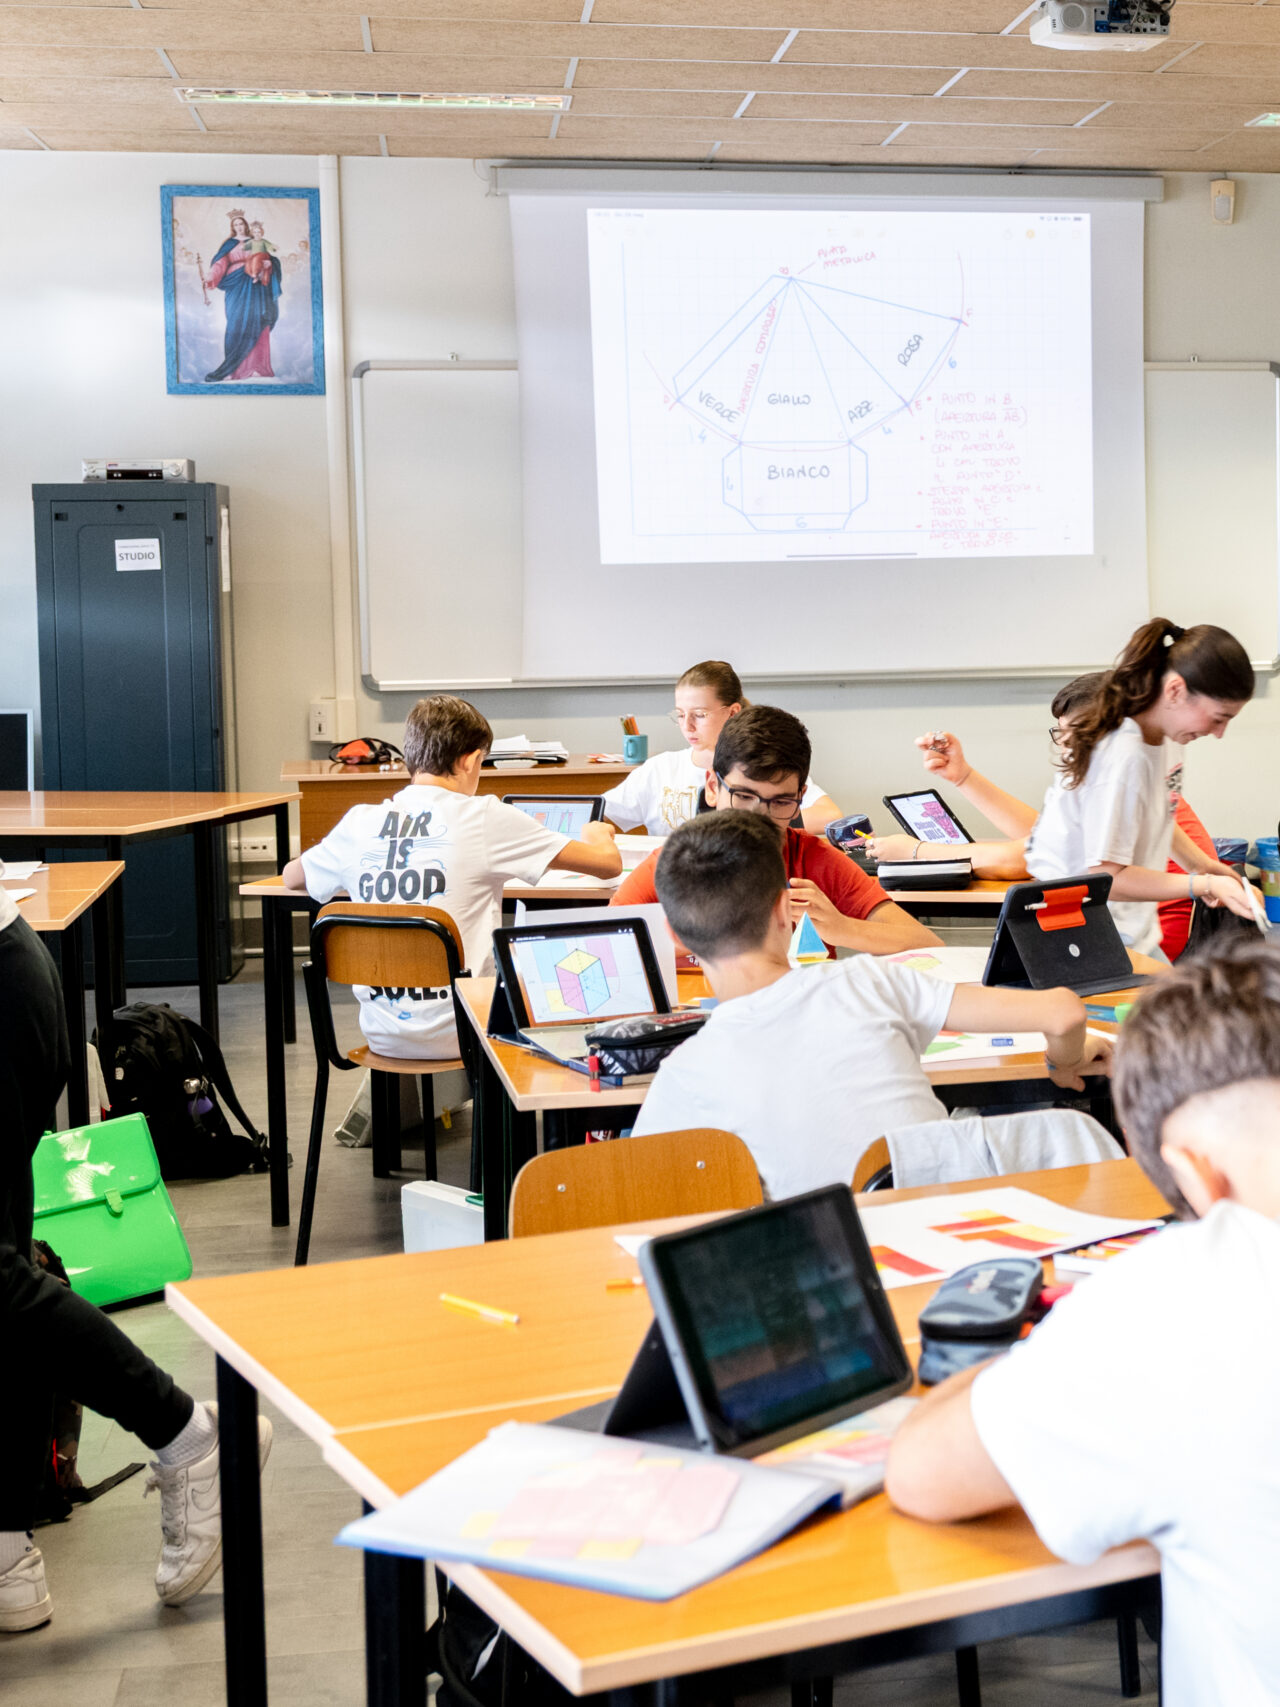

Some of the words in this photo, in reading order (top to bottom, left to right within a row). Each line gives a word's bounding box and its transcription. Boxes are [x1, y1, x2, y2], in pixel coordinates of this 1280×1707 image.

[897, 333, 924, 367] ROSA
[698, 391, 739, 423] VERDE
[767, 393, 812, 406] GIALLO
[767, 465, 831, 480] BIANCO
[118, 551, 155, 562] STUDIO
[379, 811, 431, 838] AIR
[386, 838, 413, 870] IS
[359, 869, 445, 903] GOOD
